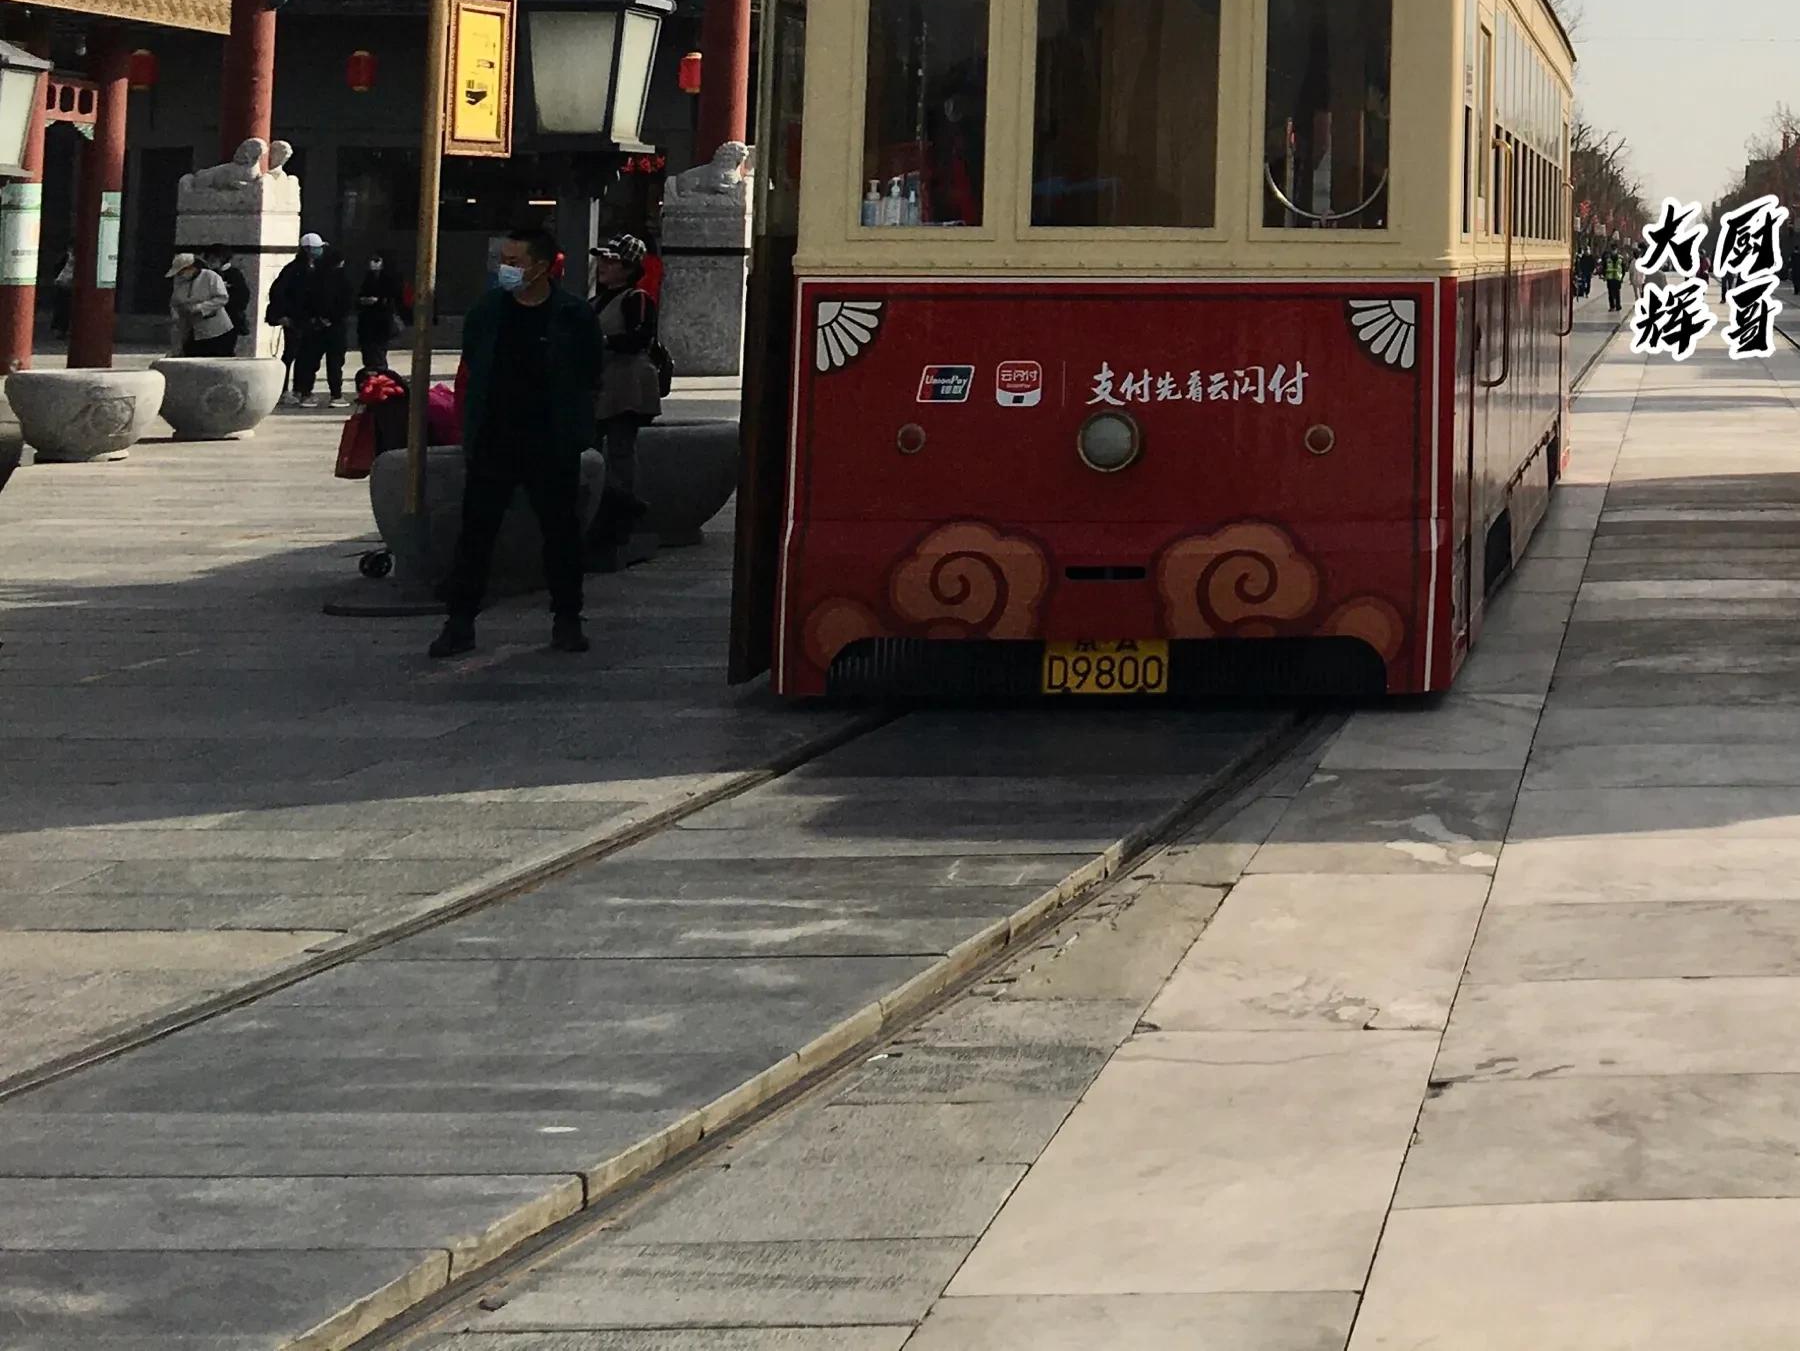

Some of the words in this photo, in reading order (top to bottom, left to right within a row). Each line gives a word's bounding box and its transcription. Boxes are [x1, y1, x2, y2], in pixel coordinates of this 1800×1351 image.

[1000, 369, 1039, 382] 云闪付
[1084, 359, 1310, 407] 支付先看云闪付
[1046, 655, 1164, 690] D9800
